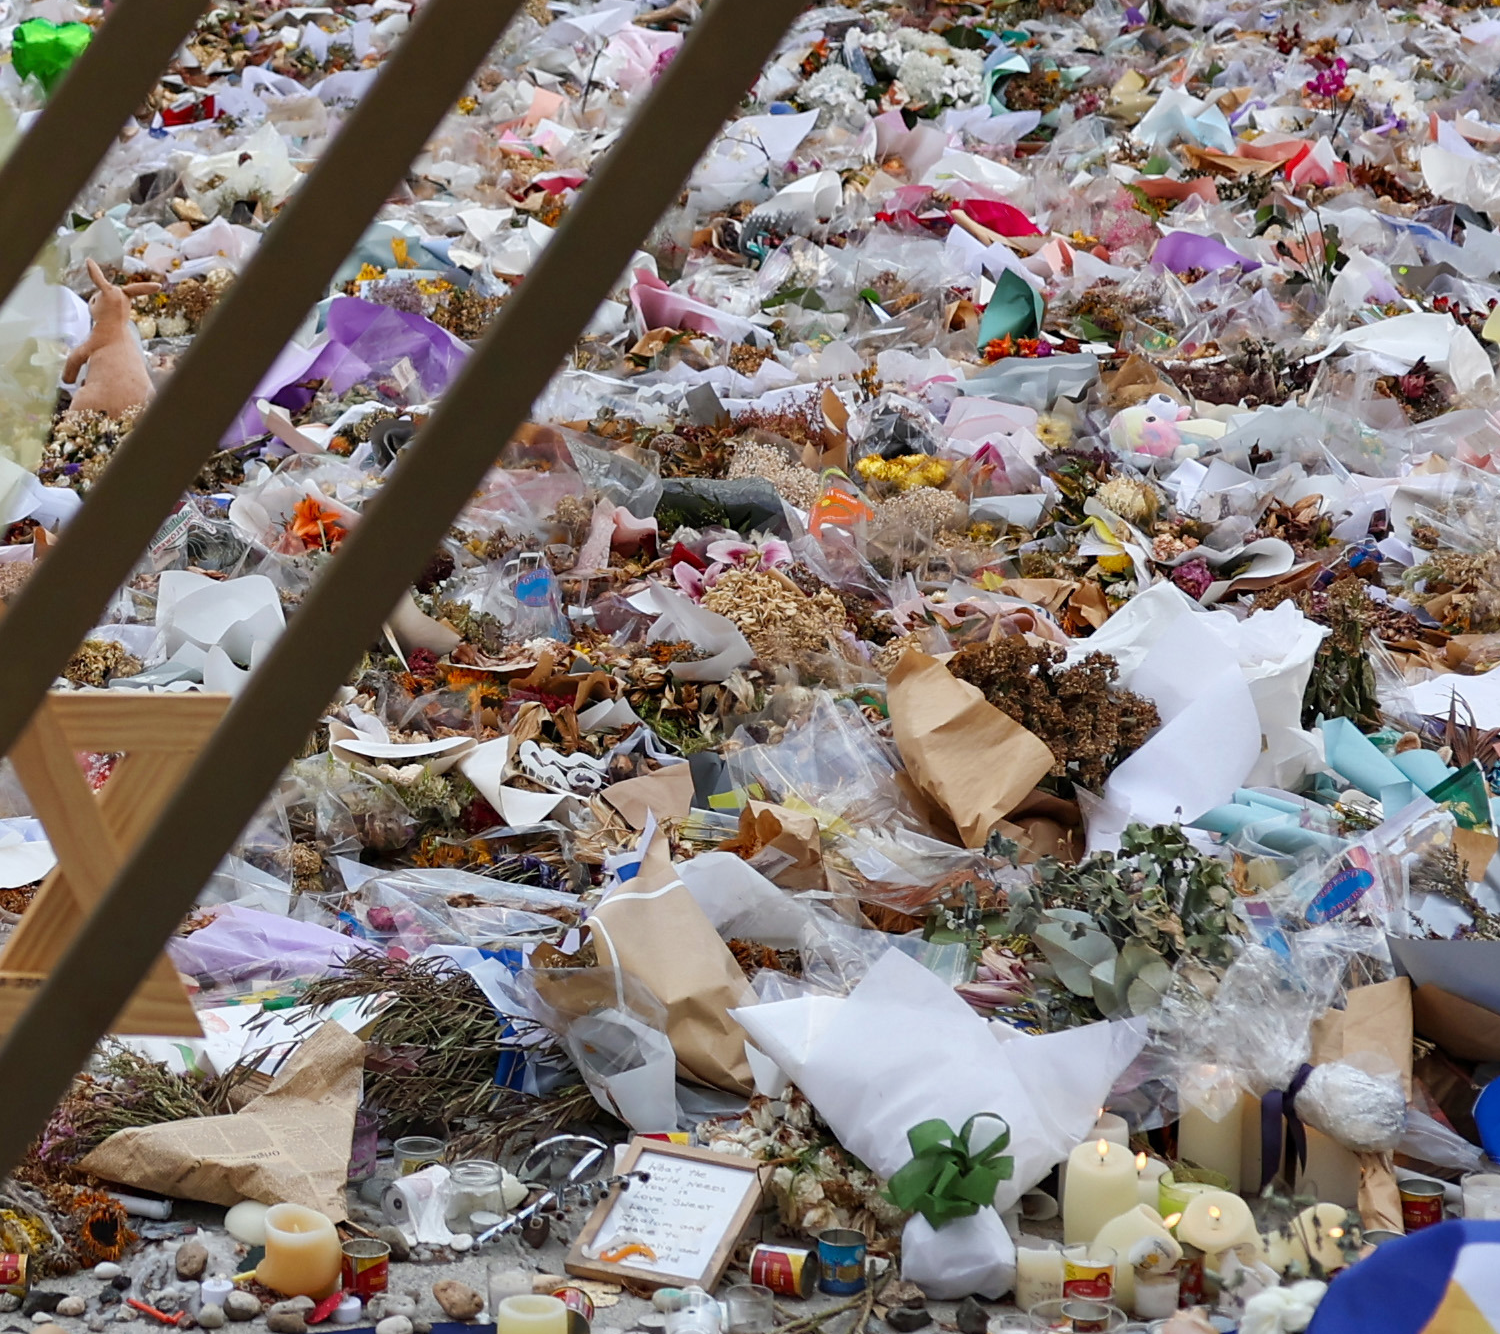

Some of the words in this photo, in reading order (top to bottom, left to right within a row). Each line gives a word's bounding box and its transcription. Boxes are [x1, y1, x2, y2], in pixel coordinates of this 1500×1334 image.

[648, 1162, 682, 1173] What
[689, 1169, 707, 1179] the
[679, 1223, 707, 1233] and
[678, 1247, 701, 1256] and
